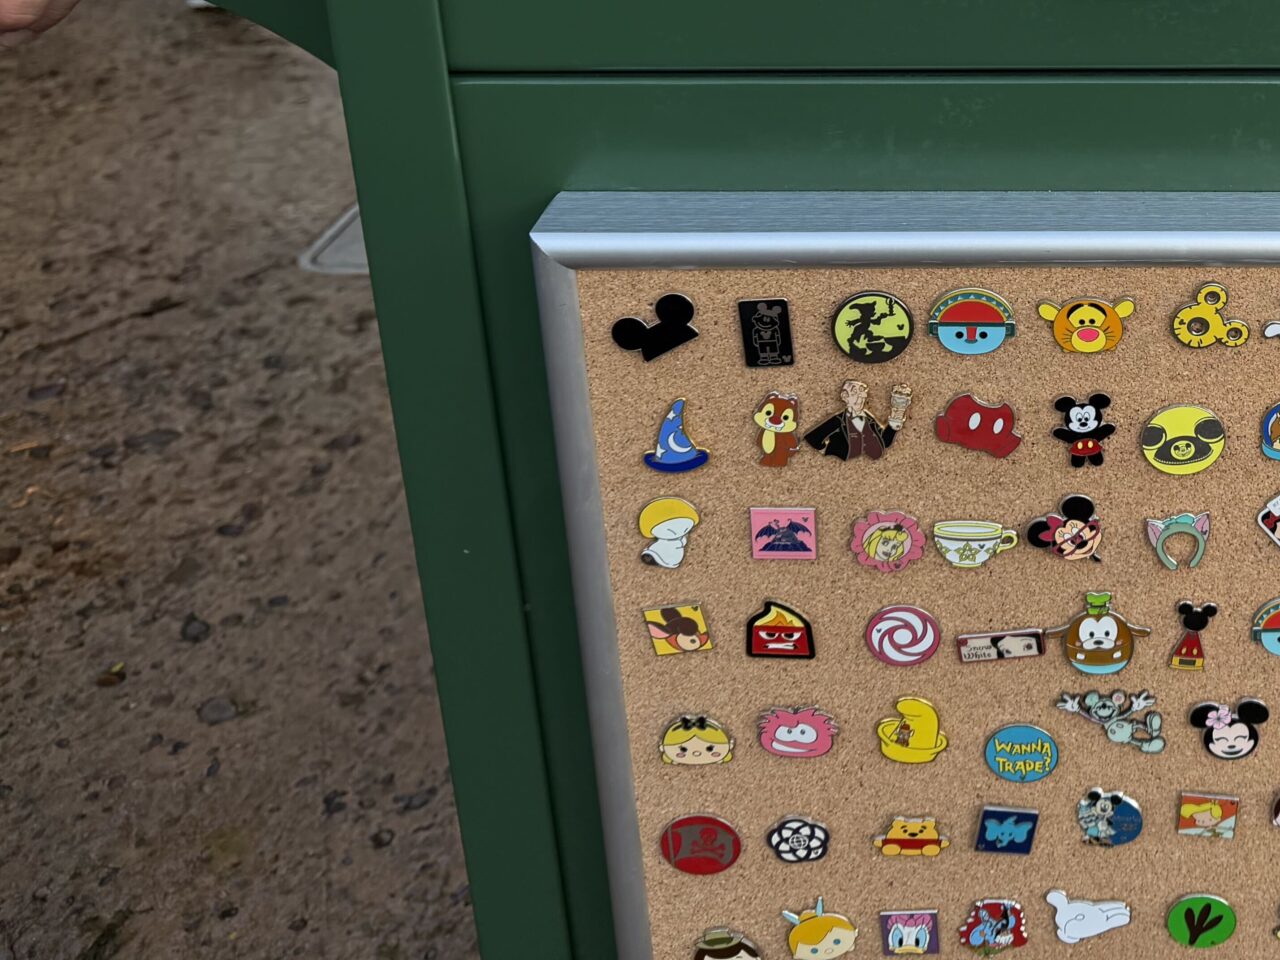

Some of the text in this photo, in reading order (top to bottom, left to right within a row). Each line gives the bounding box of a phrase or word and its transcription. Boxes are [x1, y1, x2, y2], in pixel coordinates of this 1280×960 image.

[963, 651, 992, 660] White
[994, 736, 1051, 757] WANNA
[995, 756, 1051, 776] TRADE?
